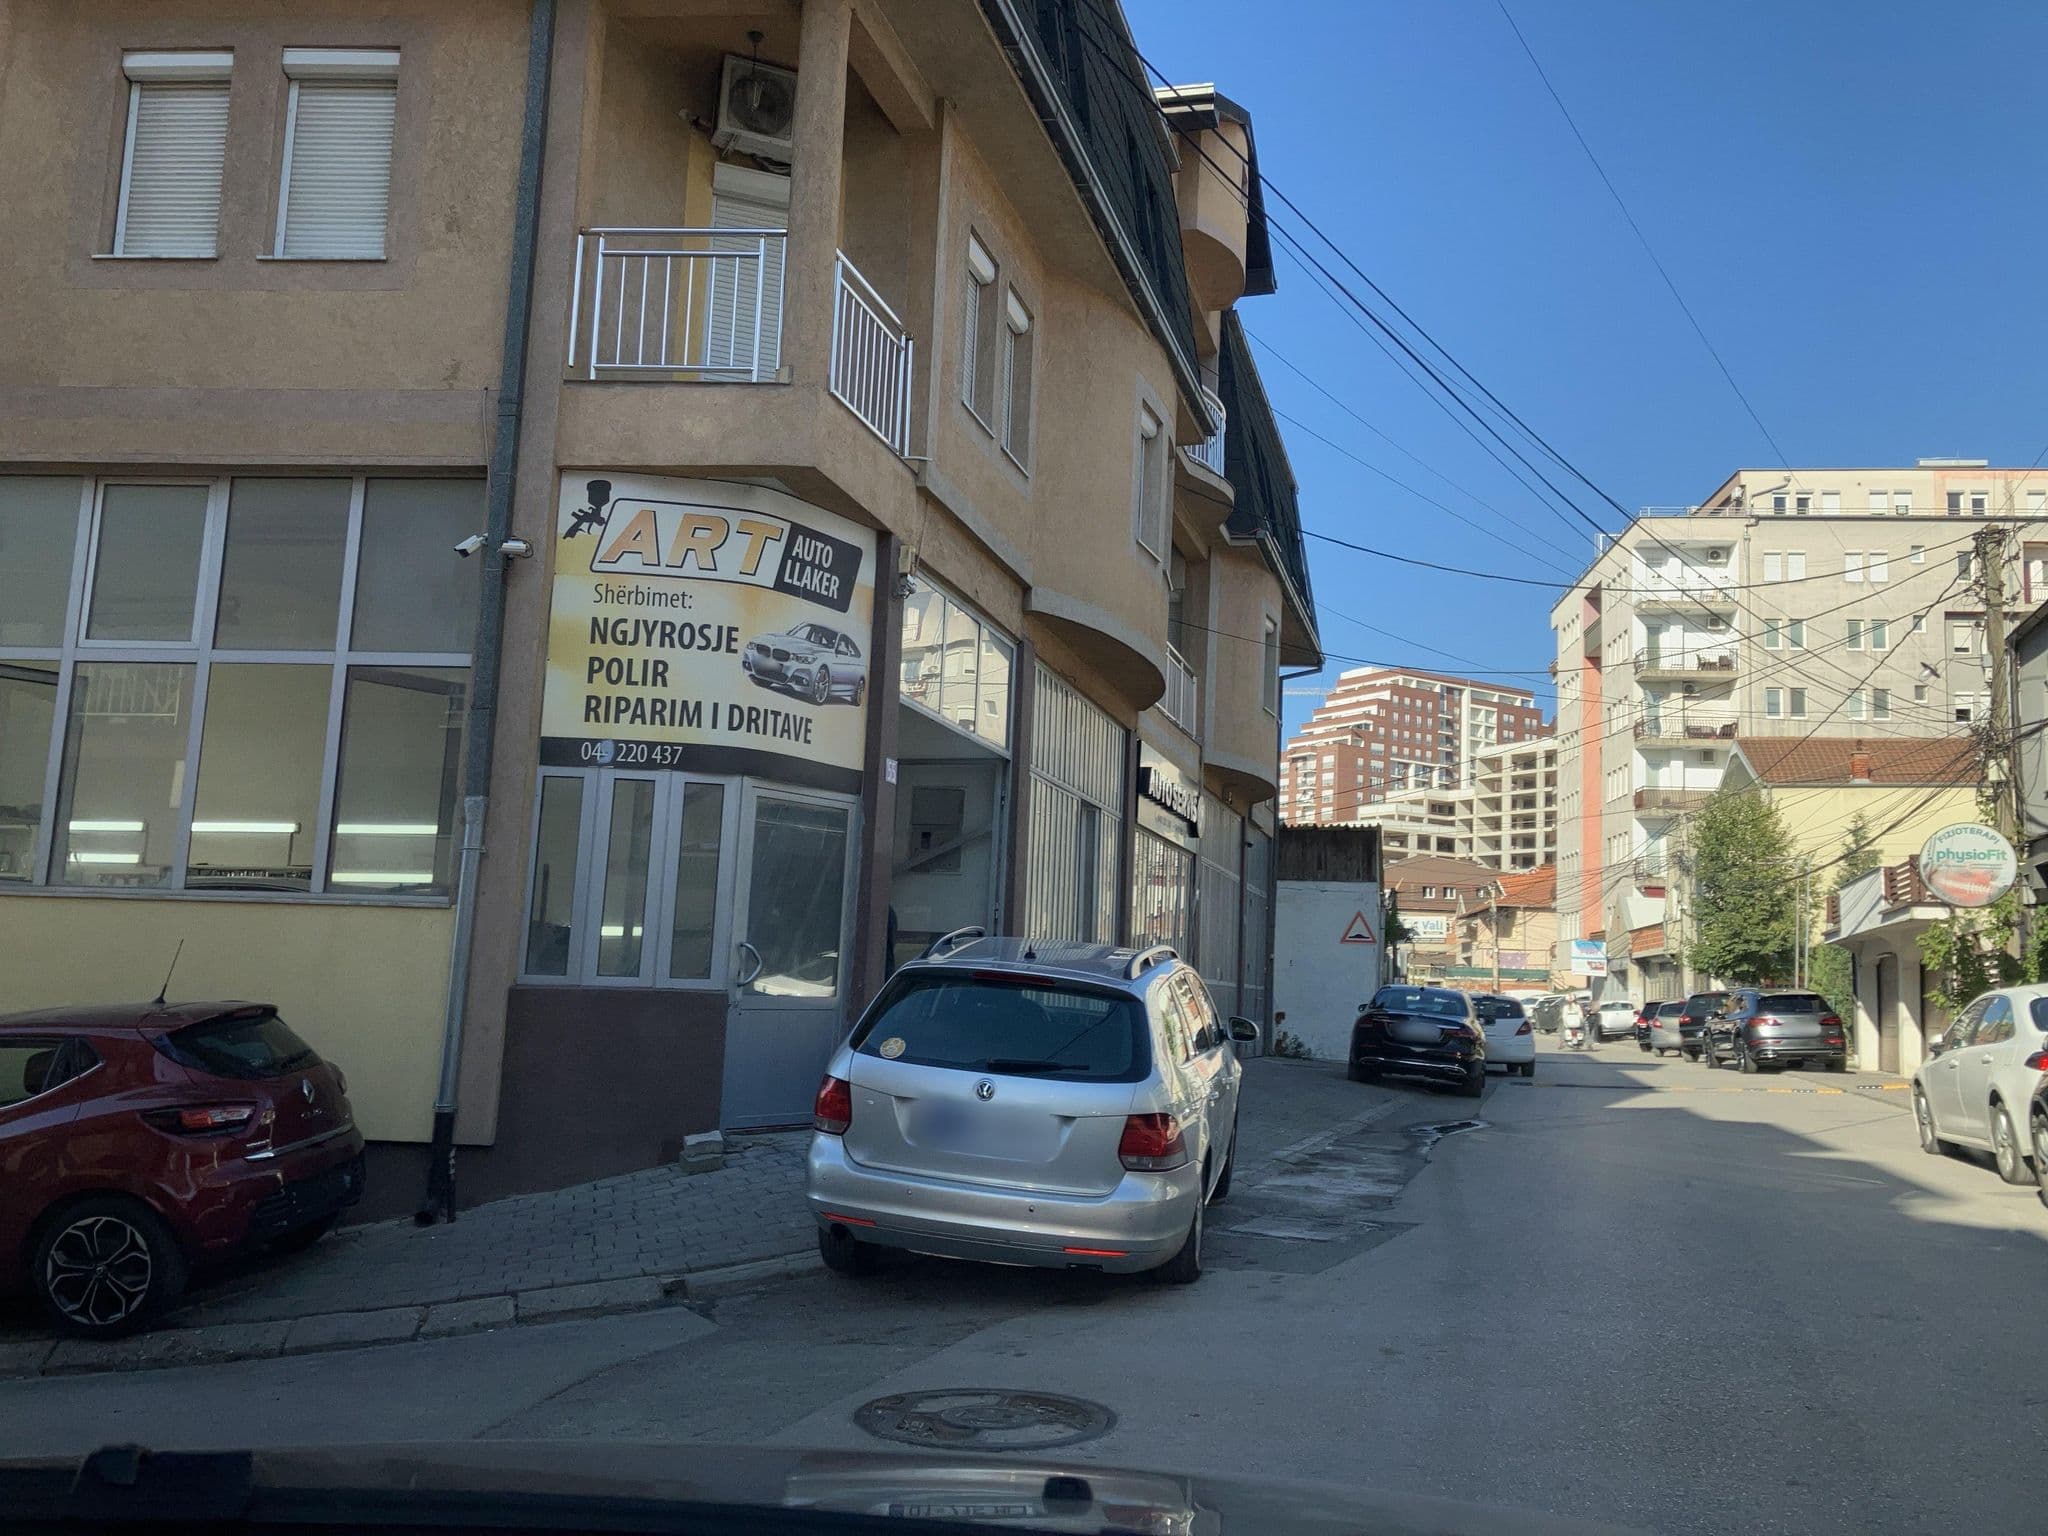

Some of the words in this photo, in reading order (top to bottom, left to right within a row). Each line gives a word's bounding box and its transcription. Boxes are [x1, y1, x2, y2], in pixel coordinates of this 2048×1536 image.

[597, 509, 784, 577] ART
[791, 534, 833, 569] AUTO
[592, 582, 693, 610] Shërbimet:
[783, 559, 840, 600] LLAKER
[589, 616, 739, 654] NGJYROSJE
[586, 656, 670, 688] POLIR
[583, 694, 702, 728] RIPARIM
[711, 702, 720, 730] I
[727, 703, 813, 745] DRITAVE
[581, 740, 614, 764] 04
[616, 743, 648, 763] 220
[651, 745, 684, 765] 437
[1937, 827, 2000, 845] FIZIOTERAPI
[1936, 848, 2008, 863] physioFit
